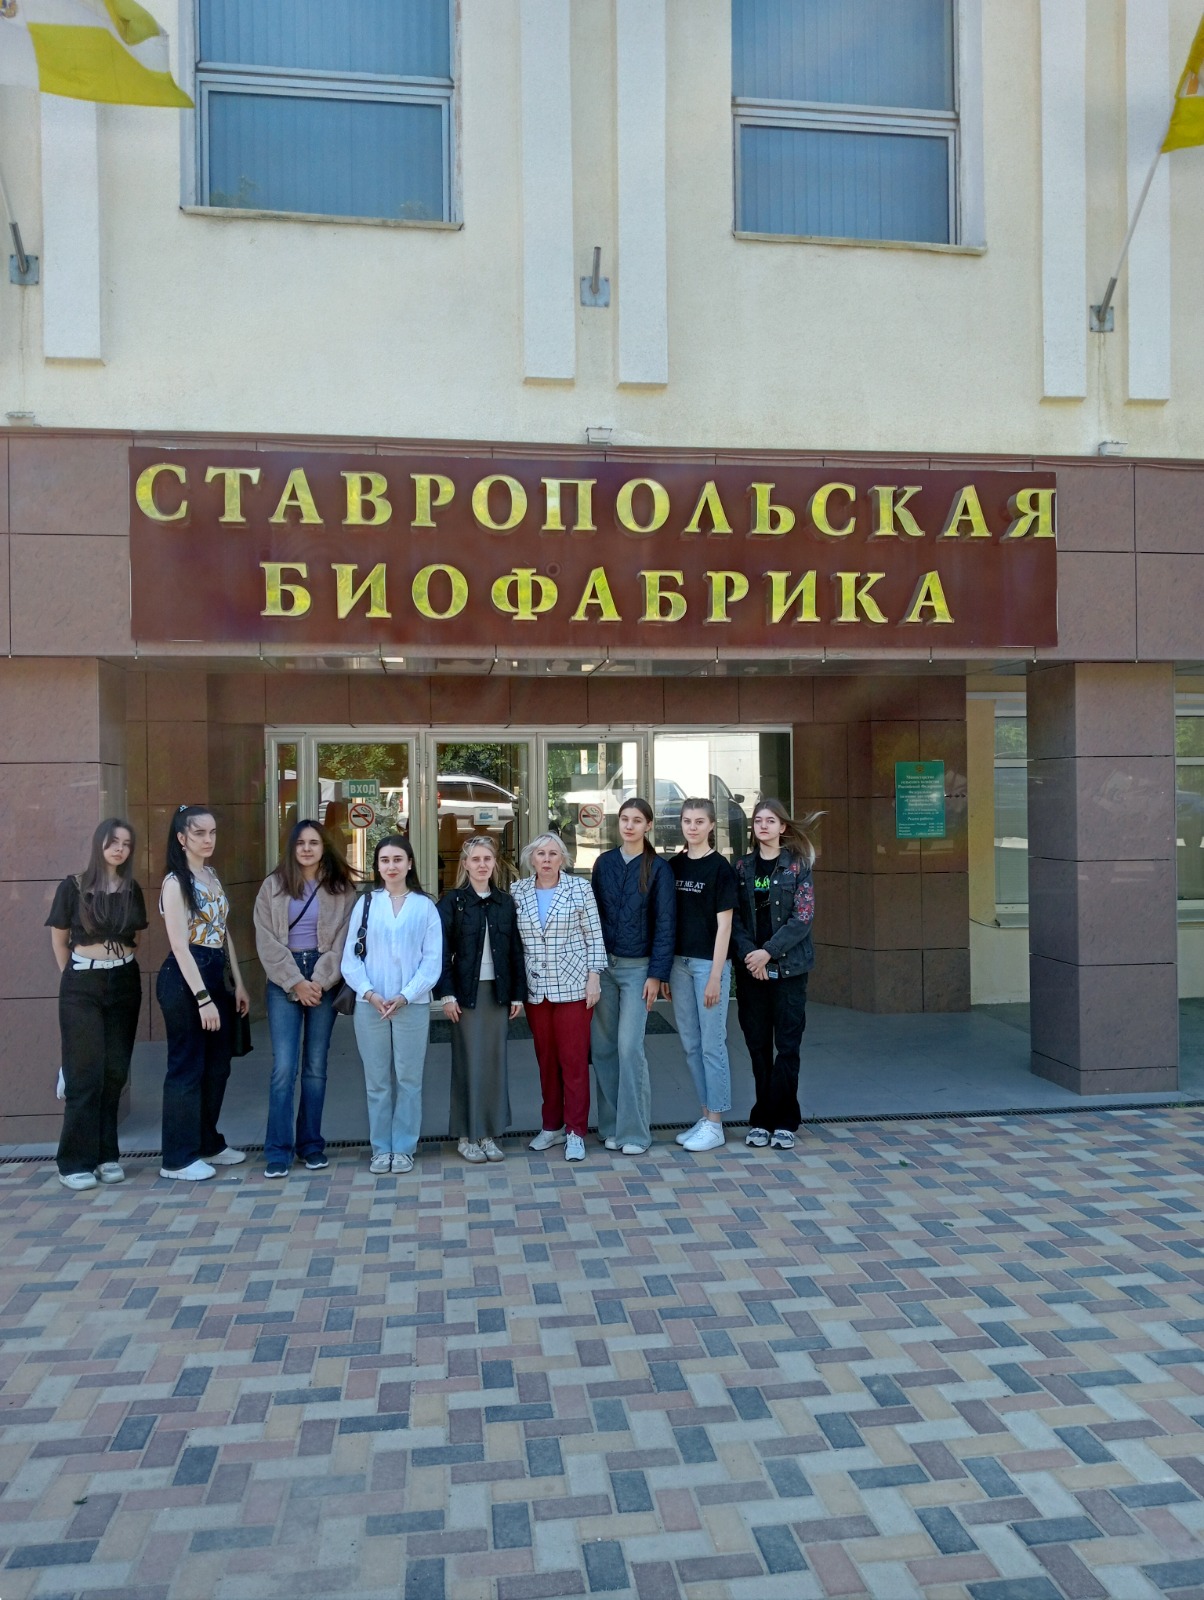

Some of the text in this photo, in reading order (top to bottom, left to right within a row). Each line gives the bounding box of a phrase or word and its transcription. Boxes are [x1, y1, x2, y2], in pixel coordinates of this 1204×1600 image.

[134, 463, 1056, 539] СТАВРОПОЛЬСКАЯ
[259, 561, 955, 625] БИОФАБРИКА
[350, 784, 375, 795] ВХОД
[694, 881, 706, 890] AT
